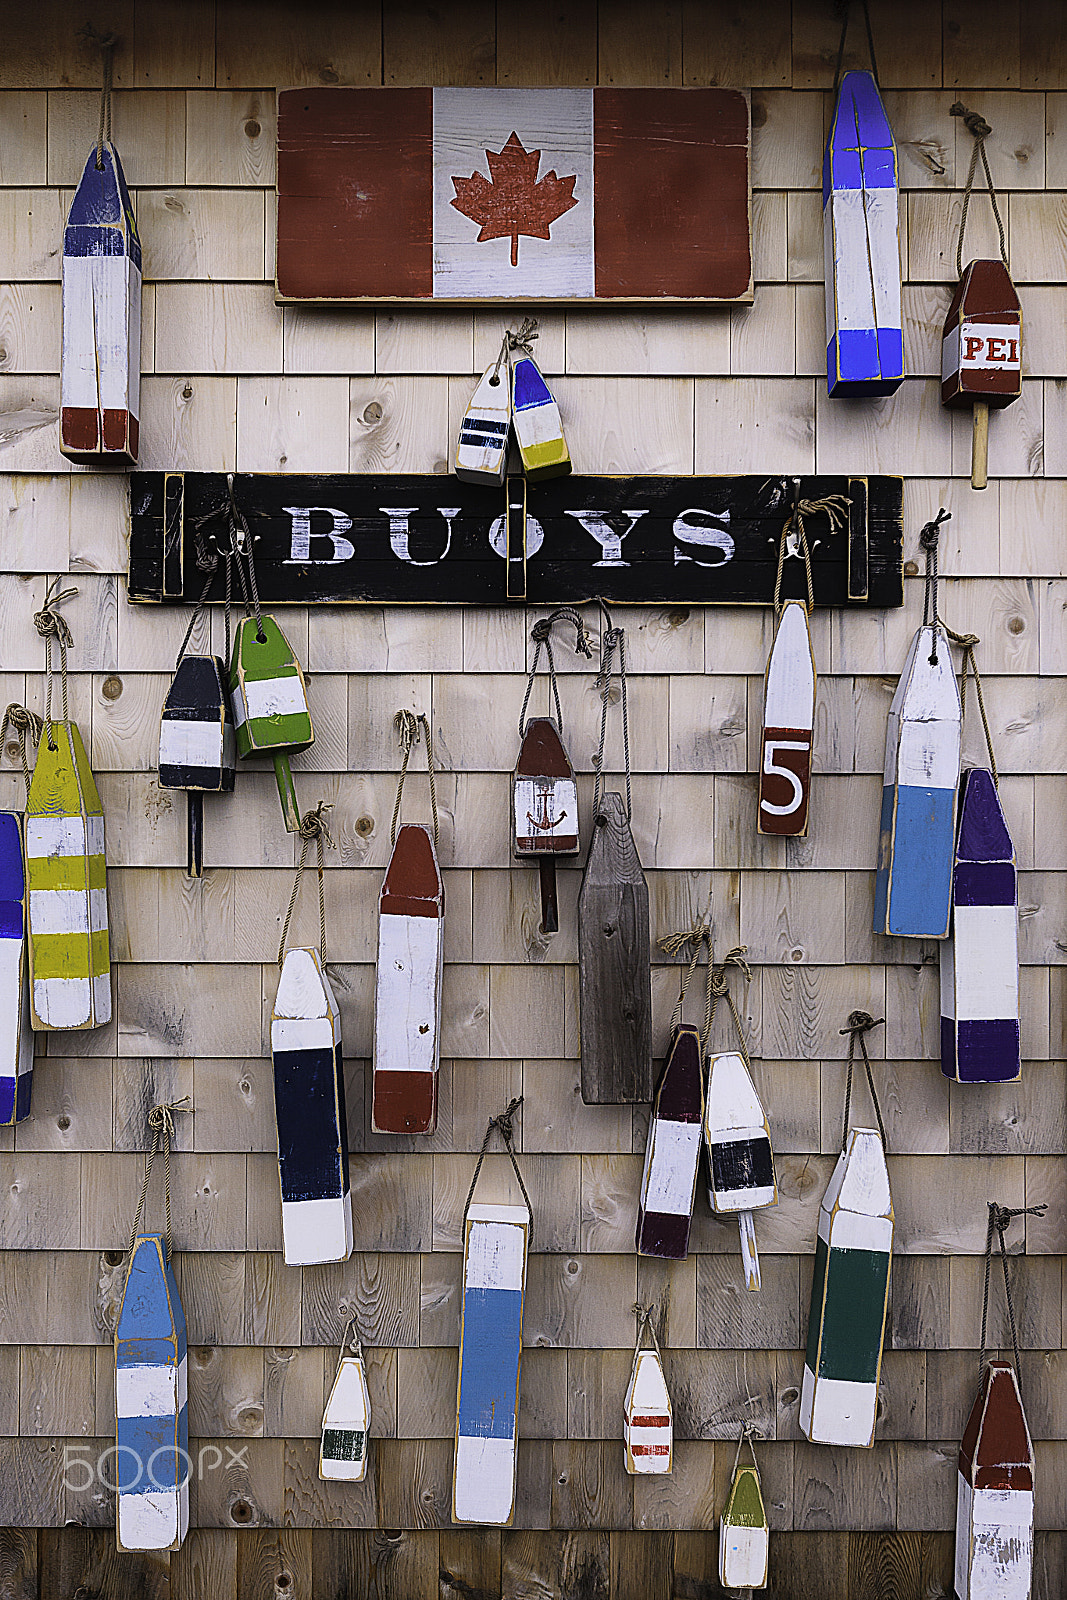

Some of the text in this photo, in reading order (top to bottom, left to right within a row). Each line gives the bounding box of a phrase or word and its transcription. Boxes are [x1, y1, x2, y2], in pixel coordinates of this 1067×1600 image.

[963, 336, 1019, 362] PEI
[282, 506, 736, 567] BUOYS
[760, 740, 810, 816] 5
